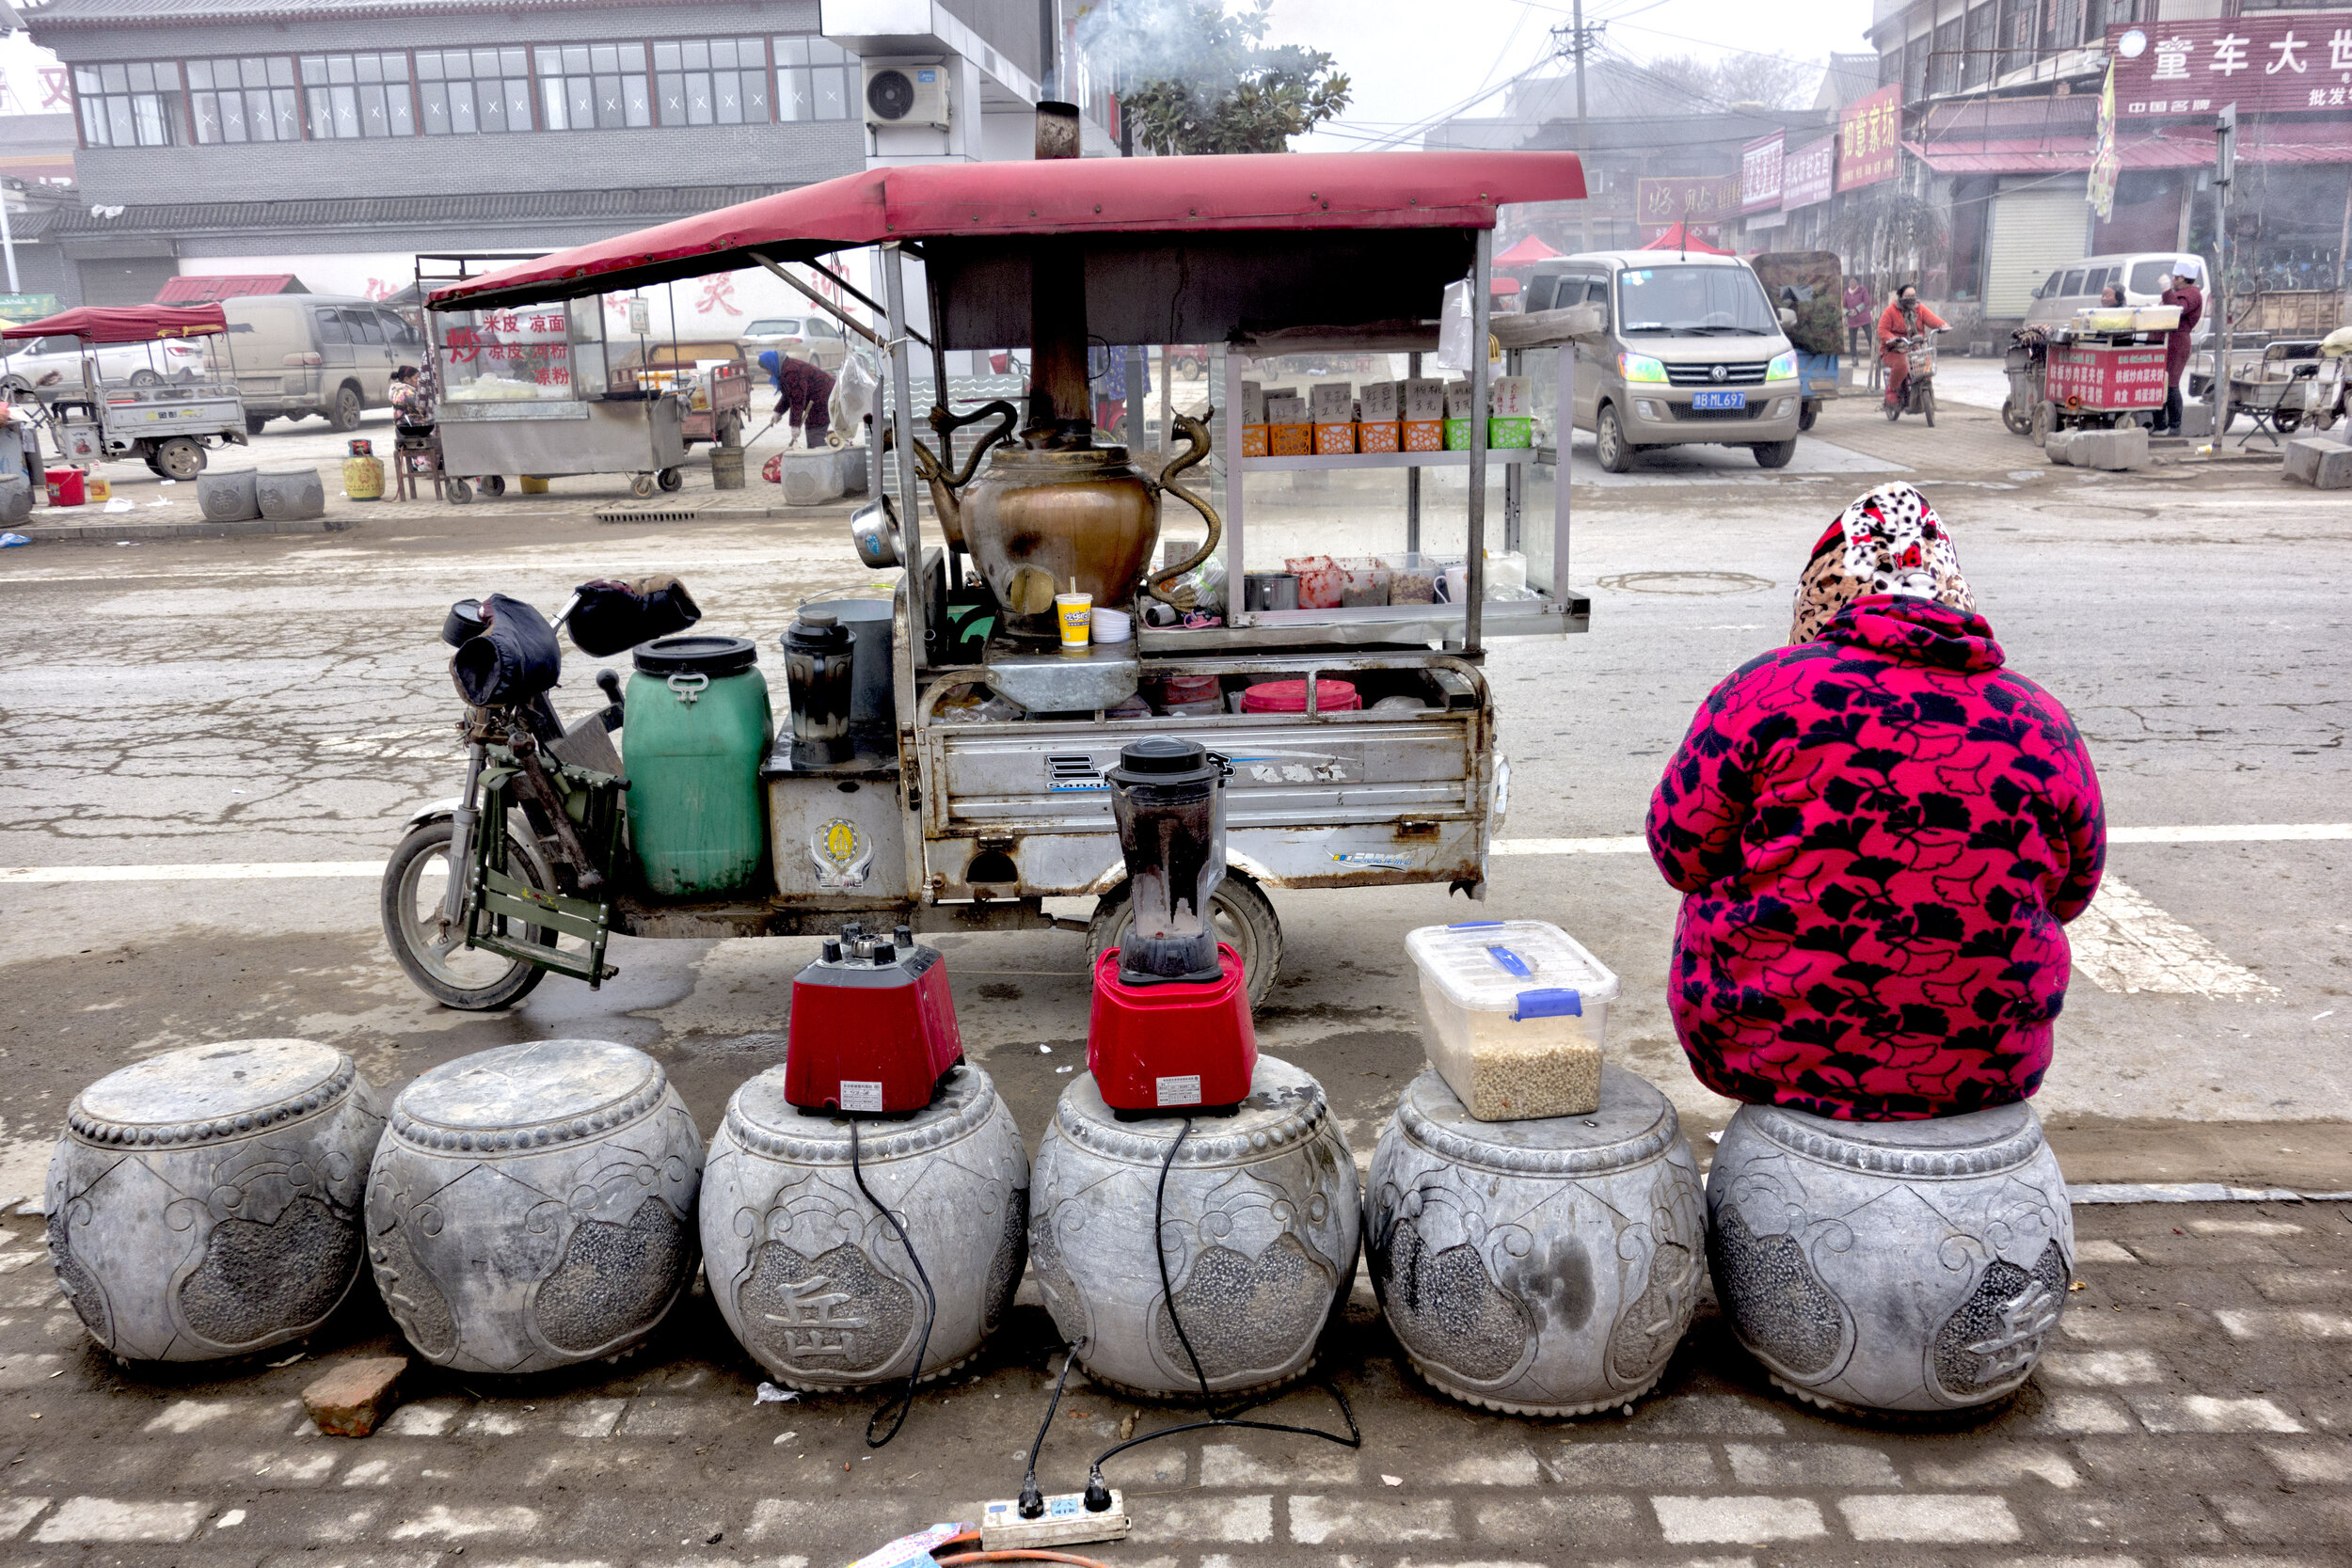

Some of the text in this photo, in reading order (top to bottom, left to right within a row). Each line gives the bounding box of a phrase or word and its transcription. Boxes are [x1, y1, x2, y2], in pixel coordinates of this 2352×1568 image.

[2308, 87, 2352, 106] 批发
[2128, 99, 2211, 114] 中国名牌
[1843, 98, 1895, 162] 如意家纺
[484, 314, 565, 333] 米皮 凉面
[446, 327, 482, 364] 炒
[487, 341, 567, 360] 凉皮 河粉
[534, 366, 570, 386] 凉粉
